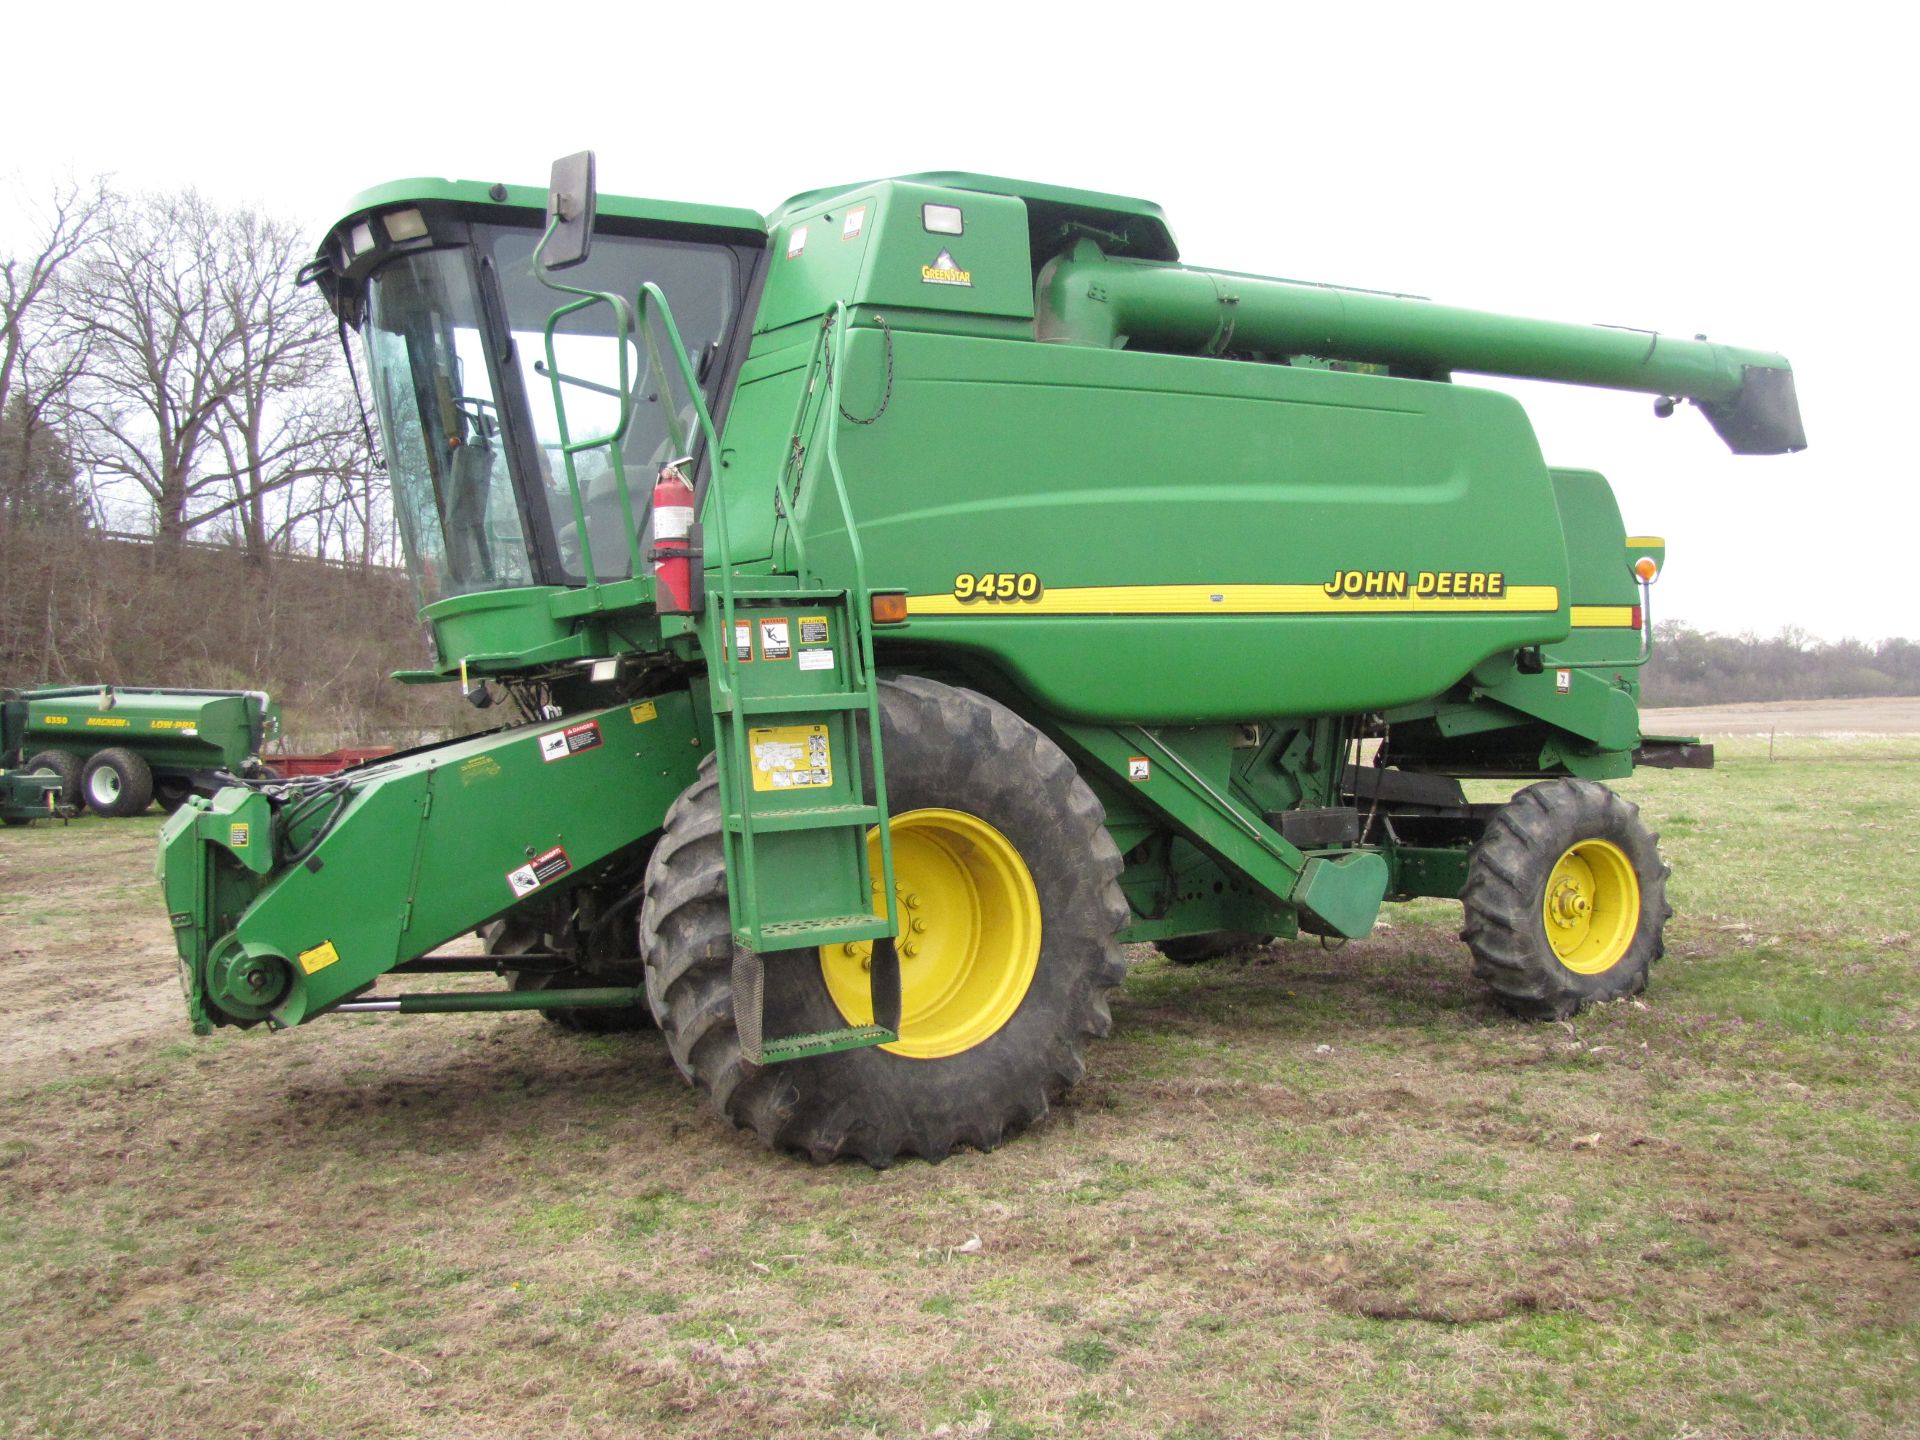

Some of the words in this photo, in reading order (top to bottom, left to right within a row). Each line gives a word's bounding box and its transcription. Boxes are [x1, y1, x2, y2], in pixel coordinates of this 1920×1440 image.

[954, 572, 1041, 603] 9450
[1323, 570, 1408, 598] JOHN
[1415, 570, 1506, 598] DEERE
[571, 722, 595, 734] DANGER
